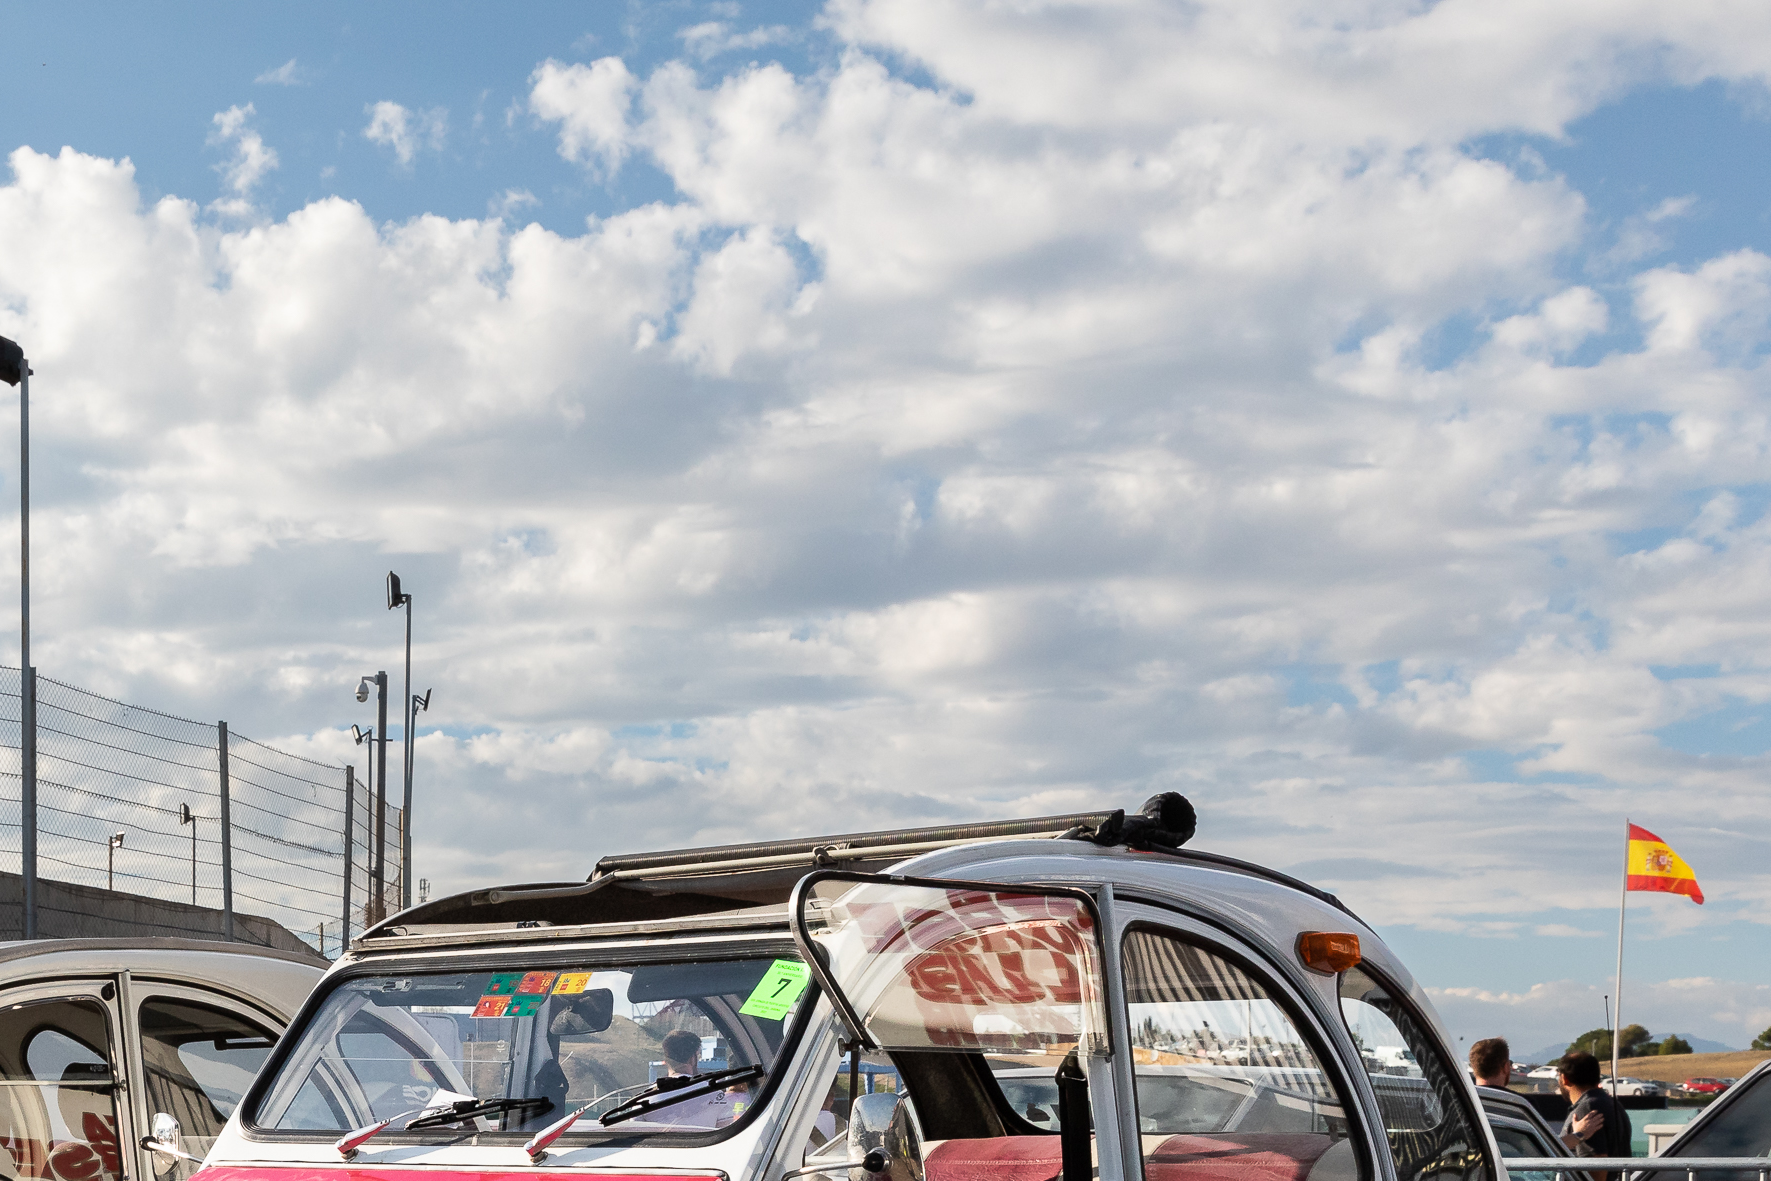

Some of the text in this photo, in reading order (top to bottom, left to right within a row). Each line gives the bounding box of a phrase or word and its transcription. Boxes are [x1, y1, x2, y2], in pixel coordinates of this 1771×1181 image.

[540, 979, 552, 987] 18
[575, 979, 588, 987] 20
[771, 977, 793, 998] 7
[493, 1002, 506, 1011] 21
